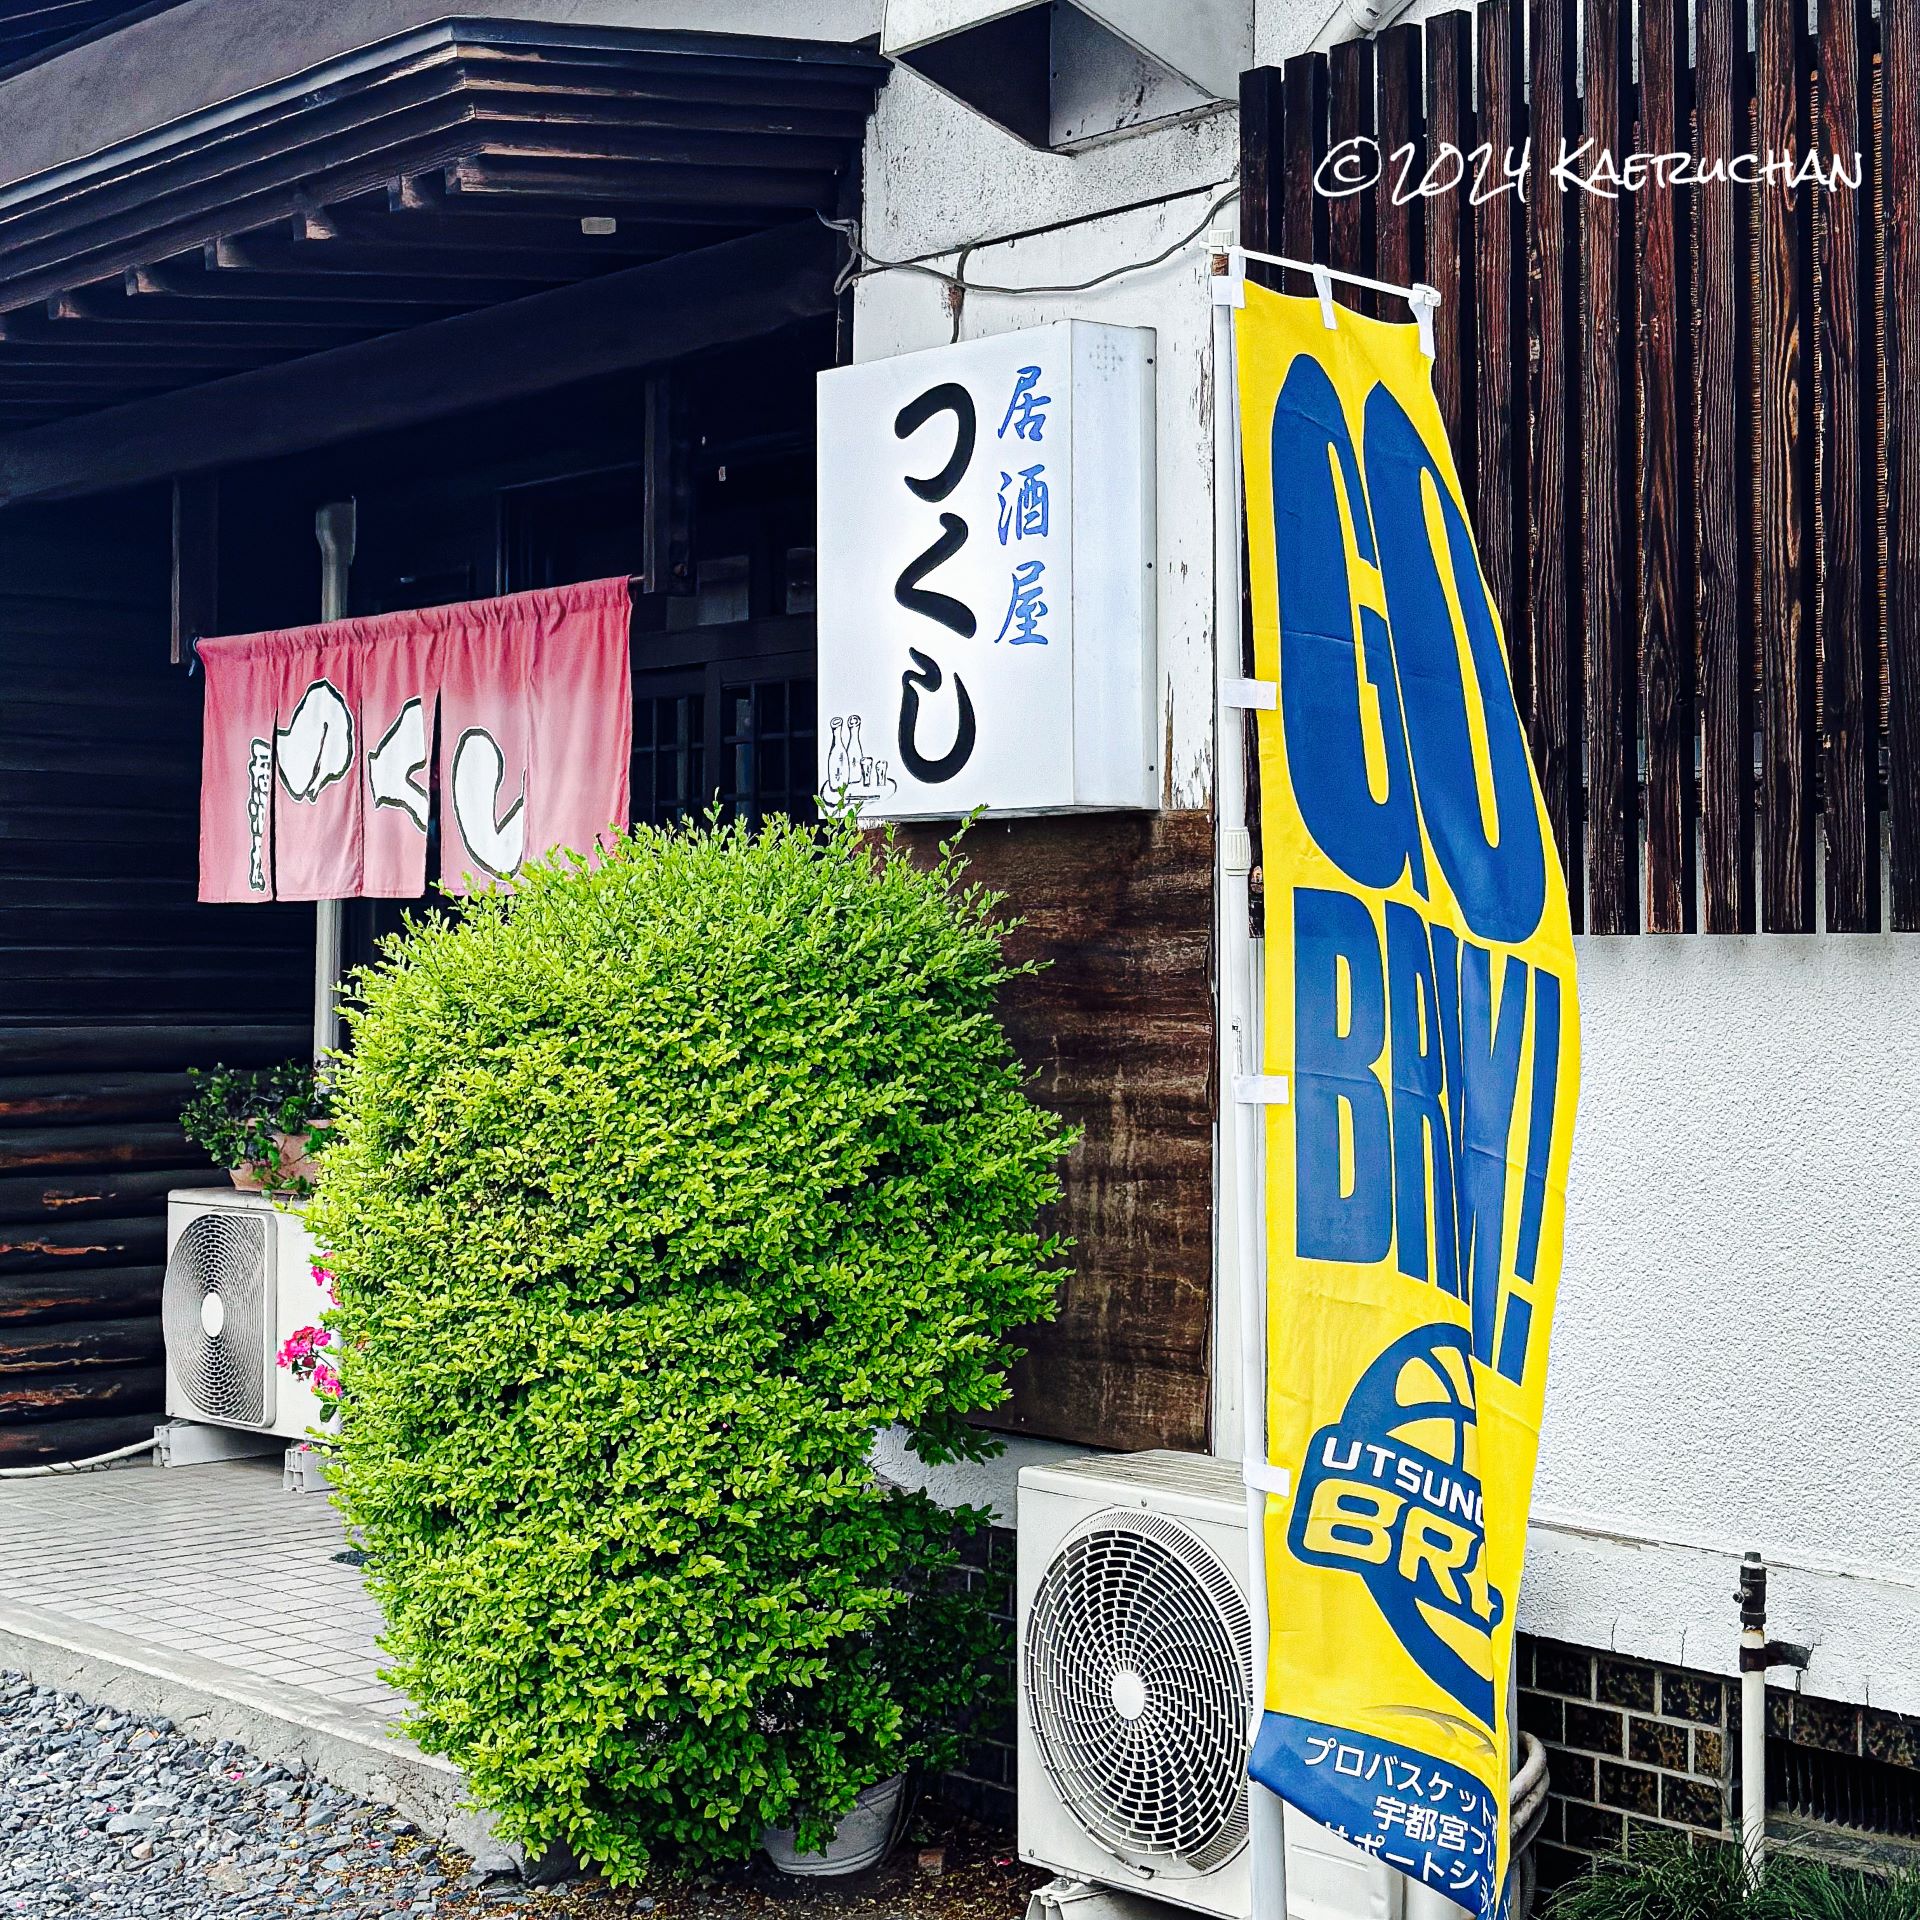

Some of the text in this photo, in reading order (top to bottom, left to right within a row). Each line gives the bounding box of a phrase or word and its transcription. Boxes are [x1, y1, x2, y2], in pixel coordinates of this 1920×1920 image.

[894, 382, 977, 784] つくし
[994, 365, 1051, 646] 居酒屋
[1272, 353, 1545, 943] GO
